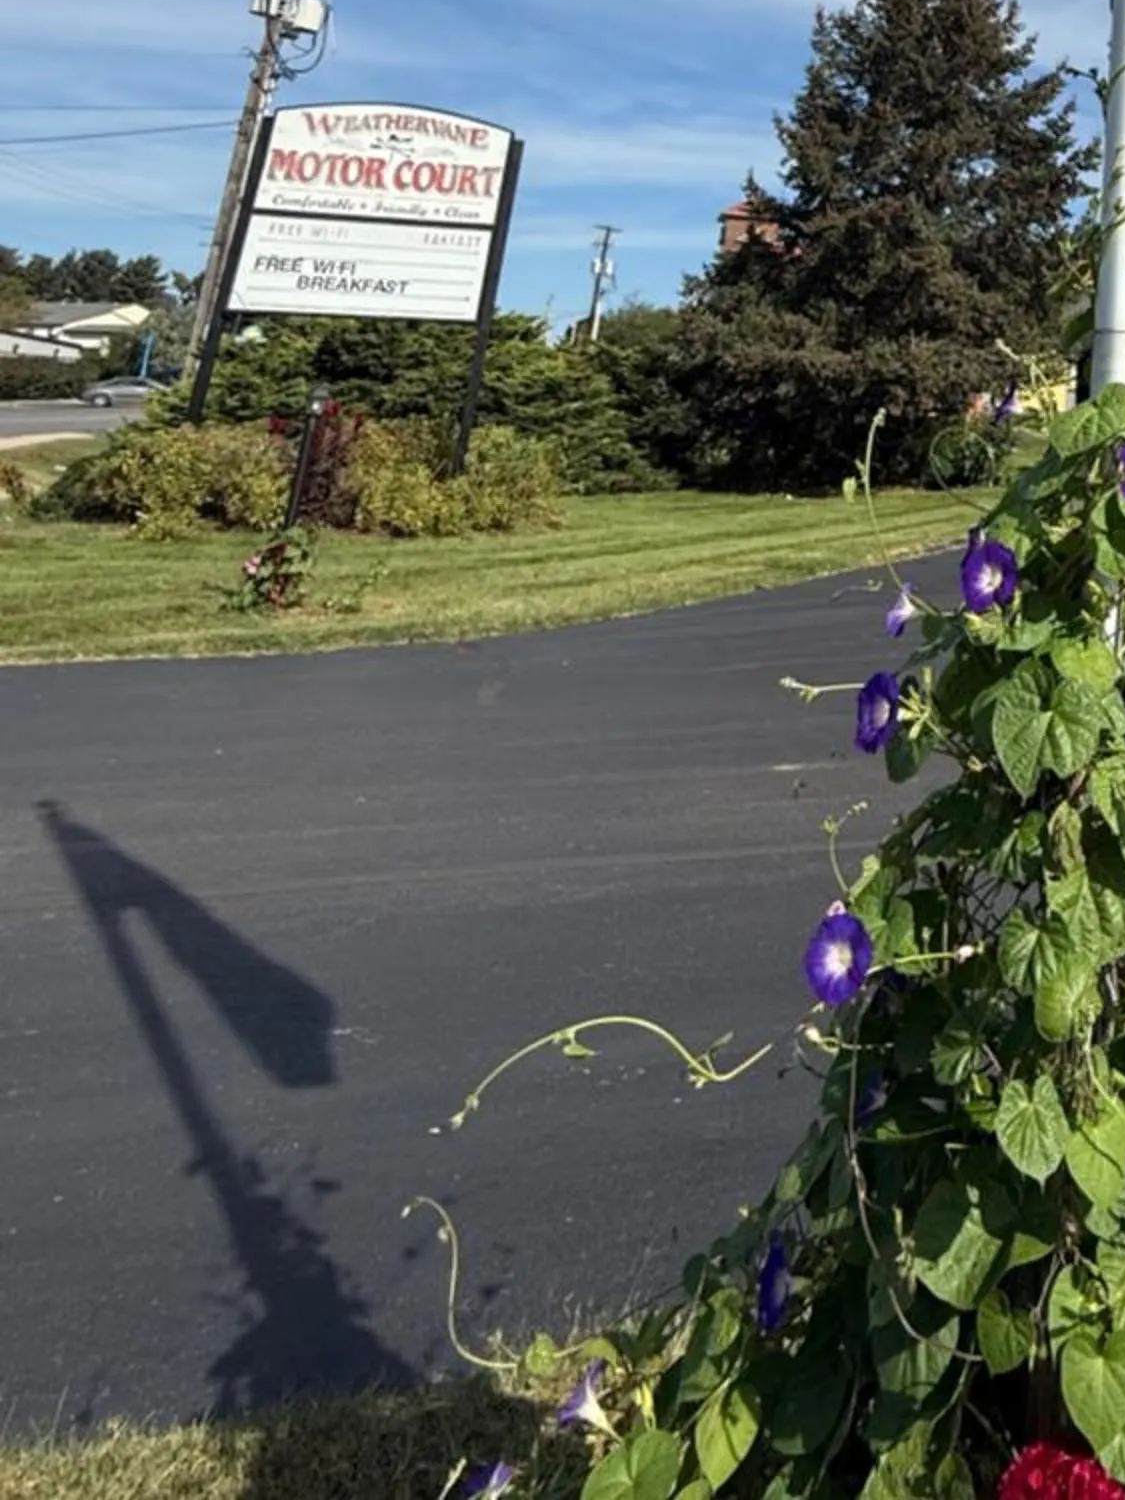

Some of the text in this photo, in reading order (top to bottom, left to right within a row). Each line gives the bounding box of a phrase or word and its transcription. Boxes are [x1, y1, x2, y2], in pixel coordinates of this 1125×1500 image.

[302, 111, 490, 150] WEATHERVANE
[266, 148, 503, 198] MOTOR COURT
[253, 254, 304, 274] FREE
[296, 274, 411, 296] BREAKFAST
